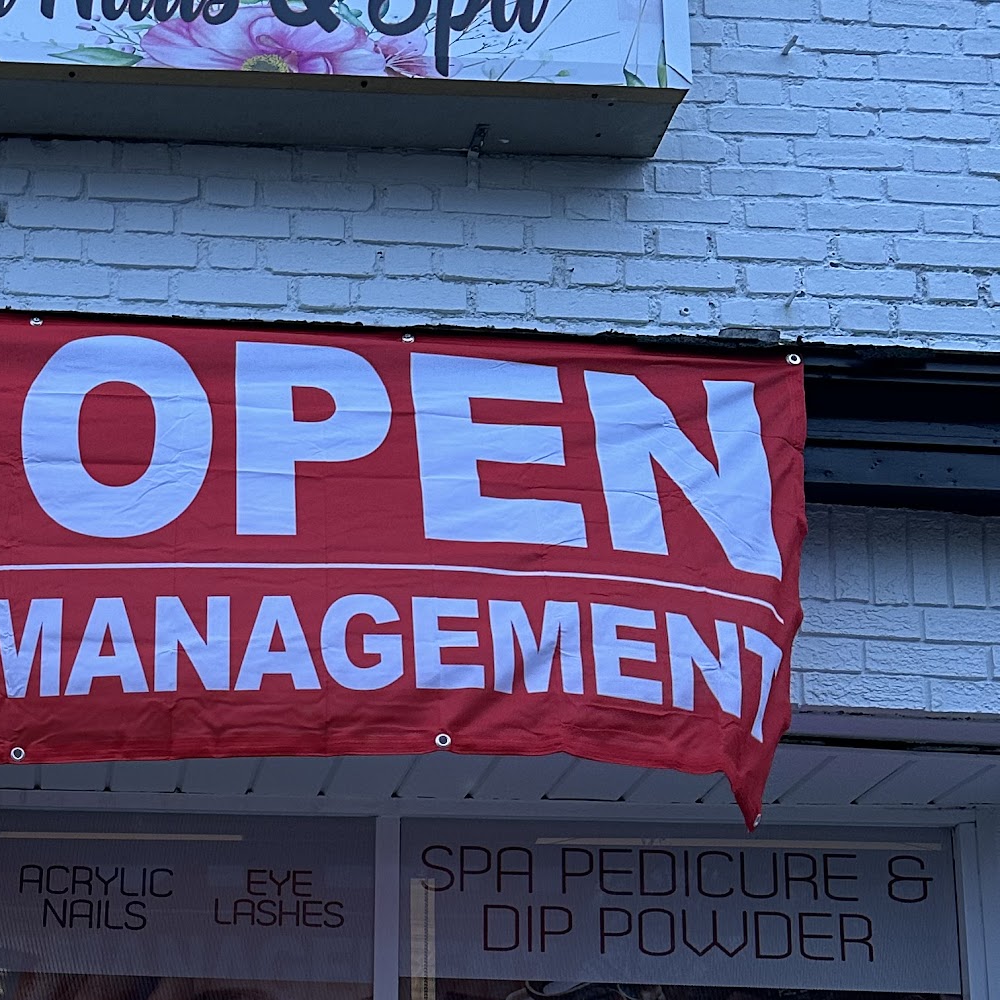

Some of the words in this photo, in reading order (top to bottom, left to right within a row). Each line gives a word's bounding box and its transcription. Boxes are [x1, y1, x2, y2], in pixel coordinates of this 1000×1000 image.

[22, 335, 784, 581] OPEN
[19, 864, 174, 898] ACRYLIC
[246, 869, 313, 898] EYE
[421, 845, 534, 894] SPA
[561, 848, 859, 902] PEDICURE
[887, 855, 934, 903] &
[42, 899, 148, 931] NAILS
[215, 898, 345, 929] LASHES
[483, 904, 573, 954] DIP
[600, 908, 875, 962] POWDER
